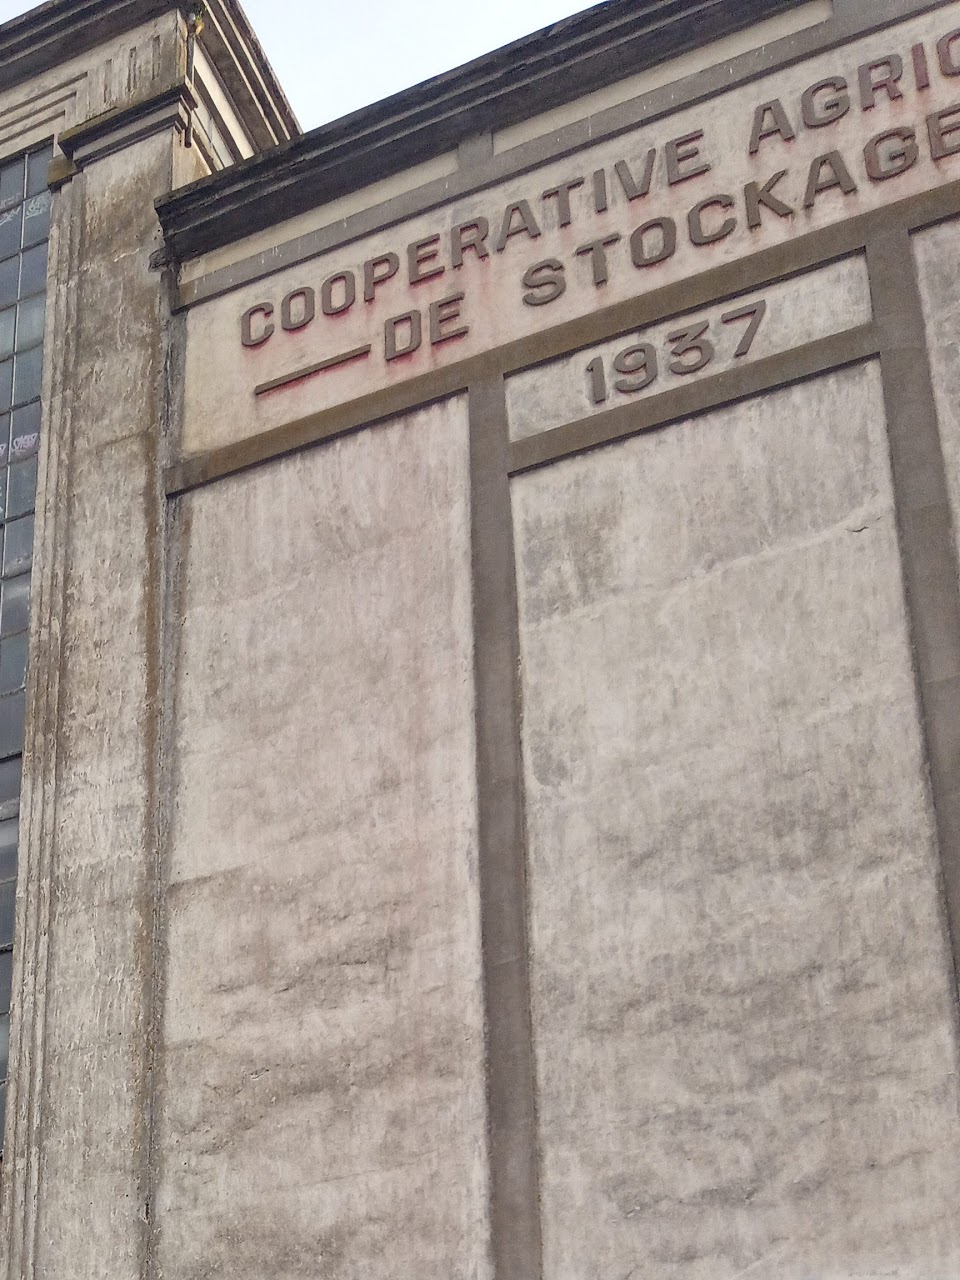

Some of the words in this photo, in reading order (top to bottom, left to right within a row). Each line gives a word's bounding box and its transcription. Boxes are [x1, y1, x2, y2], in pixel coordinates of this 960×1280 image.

[241, 129, 711, 347] COOPERATIVE
[383, 292, 470, 361] DE
[521, 102, 960, 307] STOCKAGE
[586, 299, 767, 404] 1937
